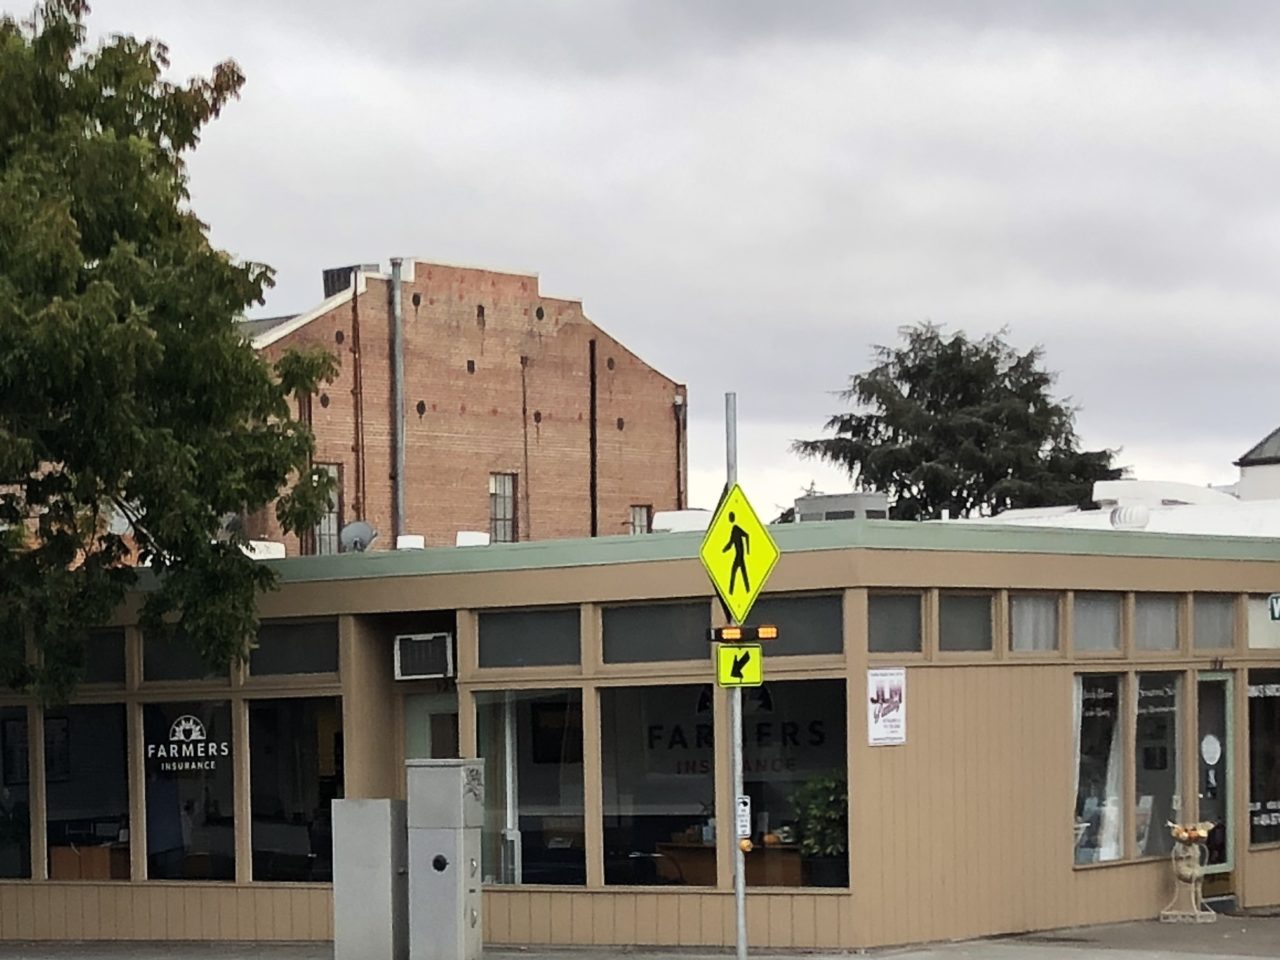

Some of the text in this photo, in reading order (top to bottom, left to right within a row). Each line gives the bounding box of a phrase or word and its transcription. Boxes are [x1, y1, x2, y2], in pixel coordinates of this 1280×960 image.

[648, 720, 826, 750] FARERS
[148, 743, 229, 758] FARMERS
[161, 761, 216, 771] INSURANCE
[676, 758, 797, 775] INSANCE
